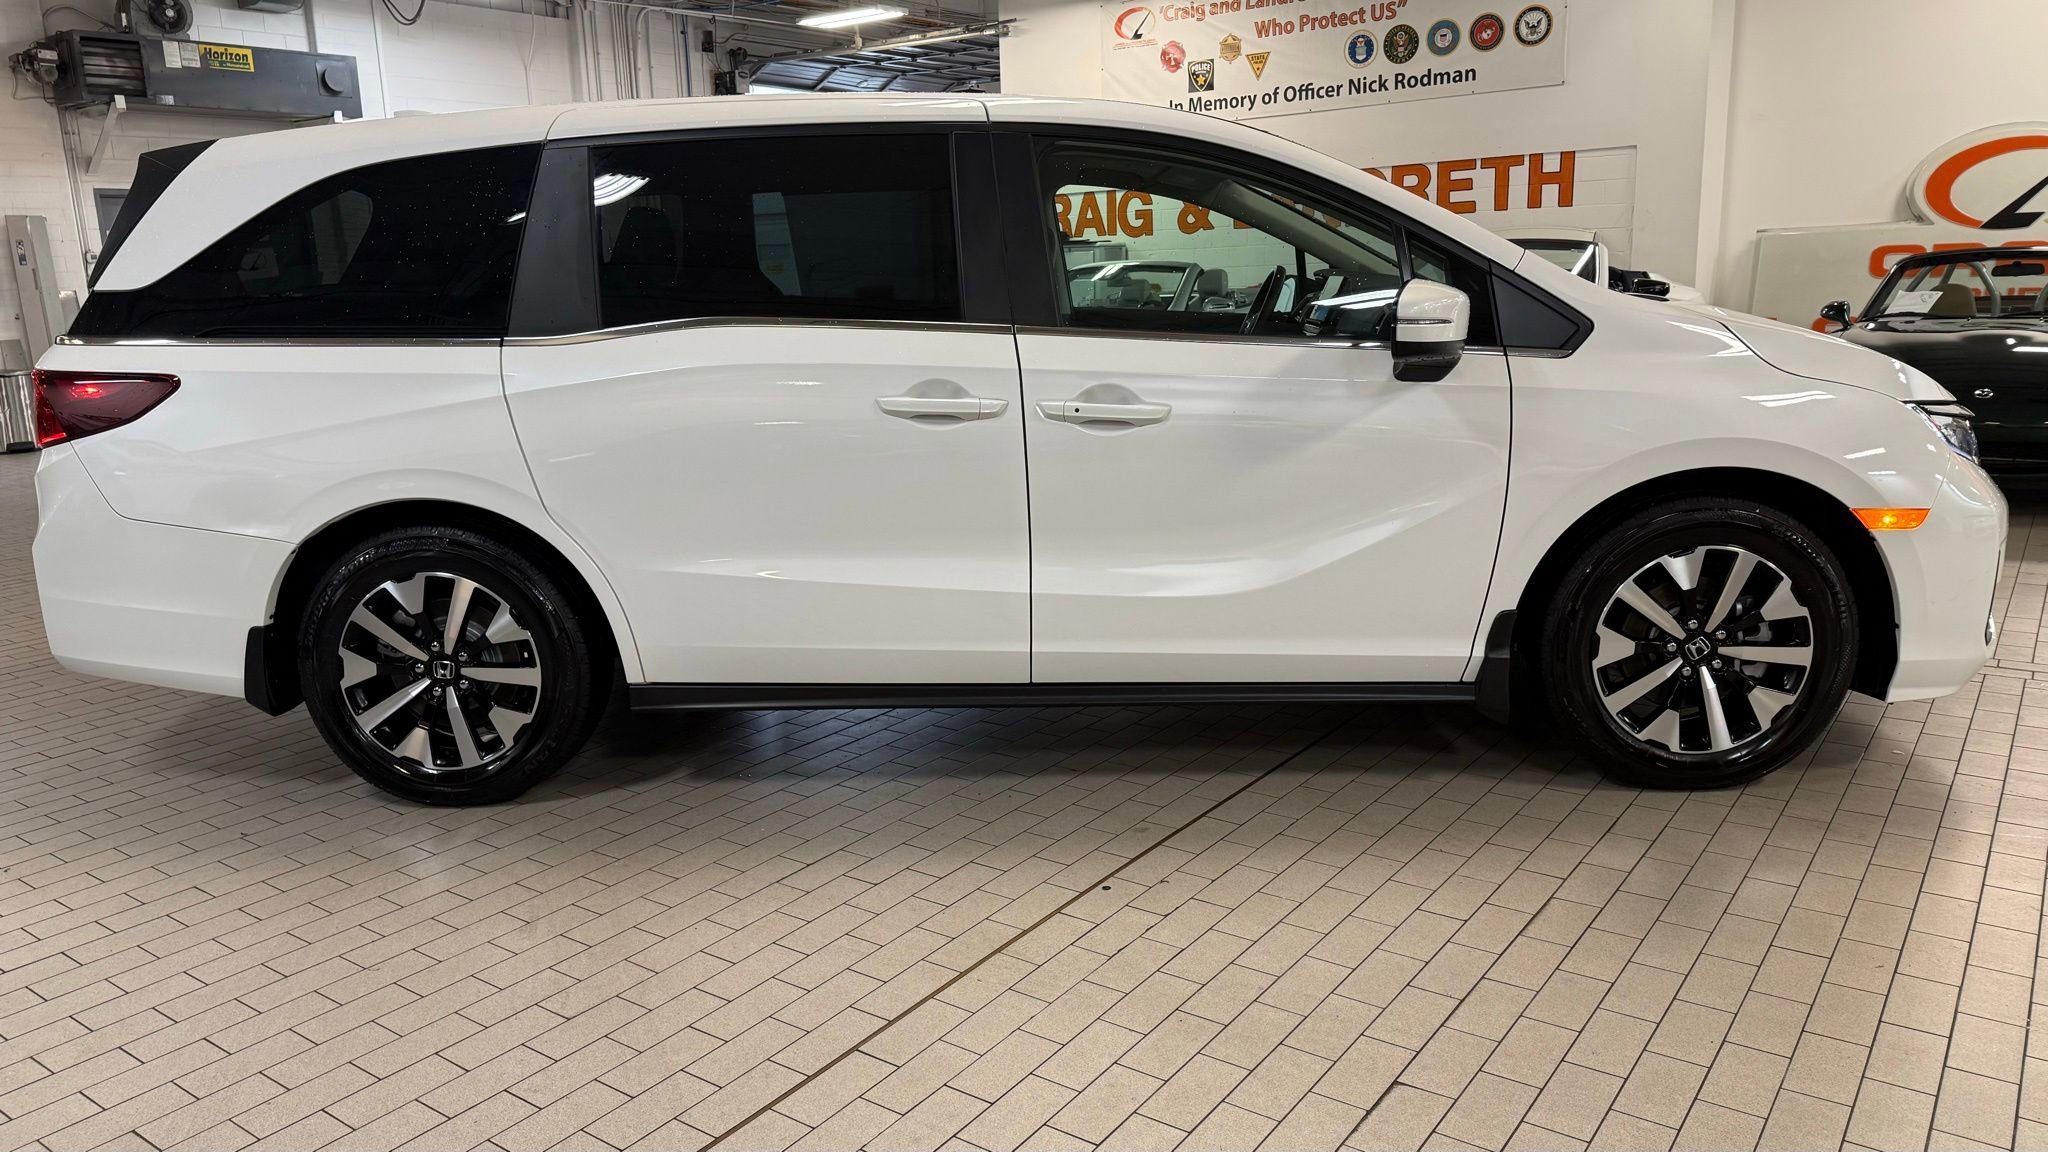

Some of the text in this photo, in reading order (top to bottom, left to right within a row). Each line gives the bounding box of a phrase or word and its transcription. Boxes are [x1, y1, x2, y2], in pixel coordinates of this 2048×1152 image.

[1209, 0, 1241, 15] and
[1254, 18, 1295, 38] Who
[1299, 7, 1366, 32] Protect
[203, 47, 249, 62] Horizon
[1191, 62, 1211, 73] POLICE
[1169, 68, 1477, 112] In Memory of Officer Nick Rodman
[1177, 200, 1214, 235] &
